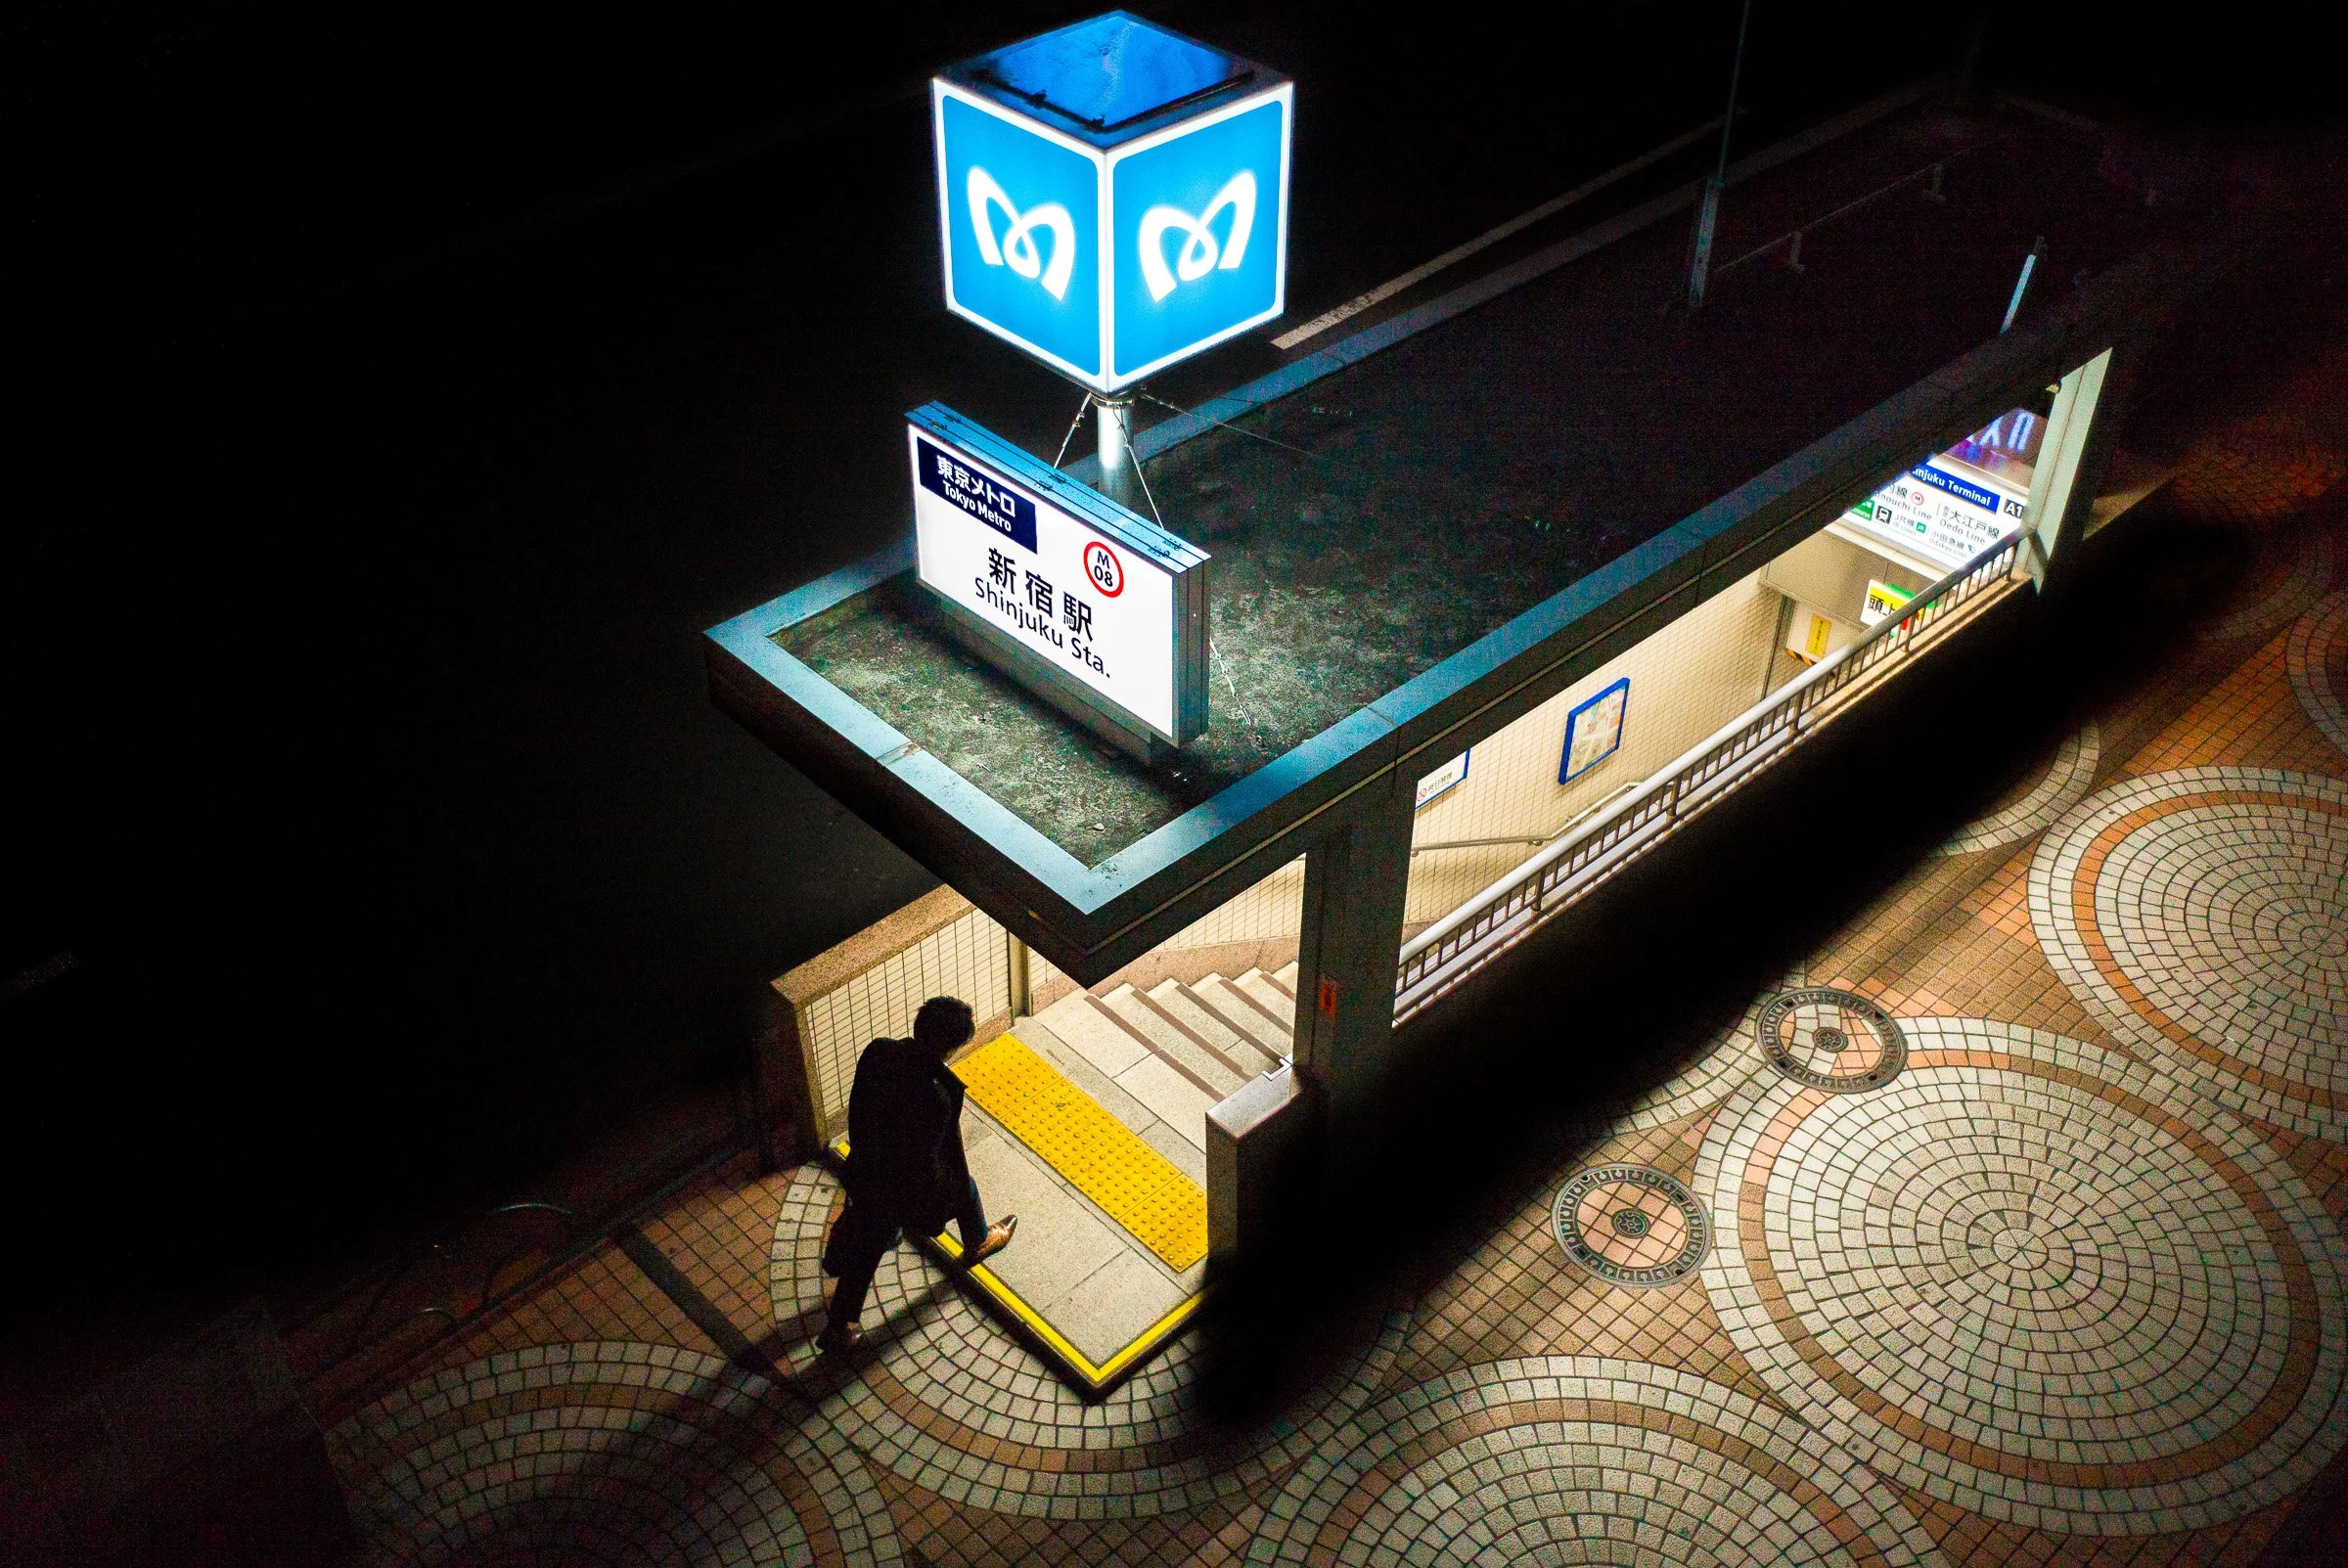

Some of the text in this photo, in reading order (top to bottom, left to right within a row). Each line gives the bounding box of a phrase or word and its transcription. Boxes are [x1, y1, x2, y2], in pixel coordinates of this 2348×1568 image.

[937, 455, 1016, 517] 東京メトロ
[1948, 479, 1991, 506] Terminal
[943, 480, 1012, 532] Tokyo Metro
[1914, 506, 1932, 521] Line
[2006, 502, 2022, 518] A1
[1940, 518, 1986, 546] Oedo Line
[1950, 510, 2000, 539] 大江戸線
[1097, 550, 1109, 569] M
[1094, 564, 1113, 588] 08
[988, 547, 1093, 642] 新宿駅
[975, 577, 1110, 679] Shinjuku Sta.
